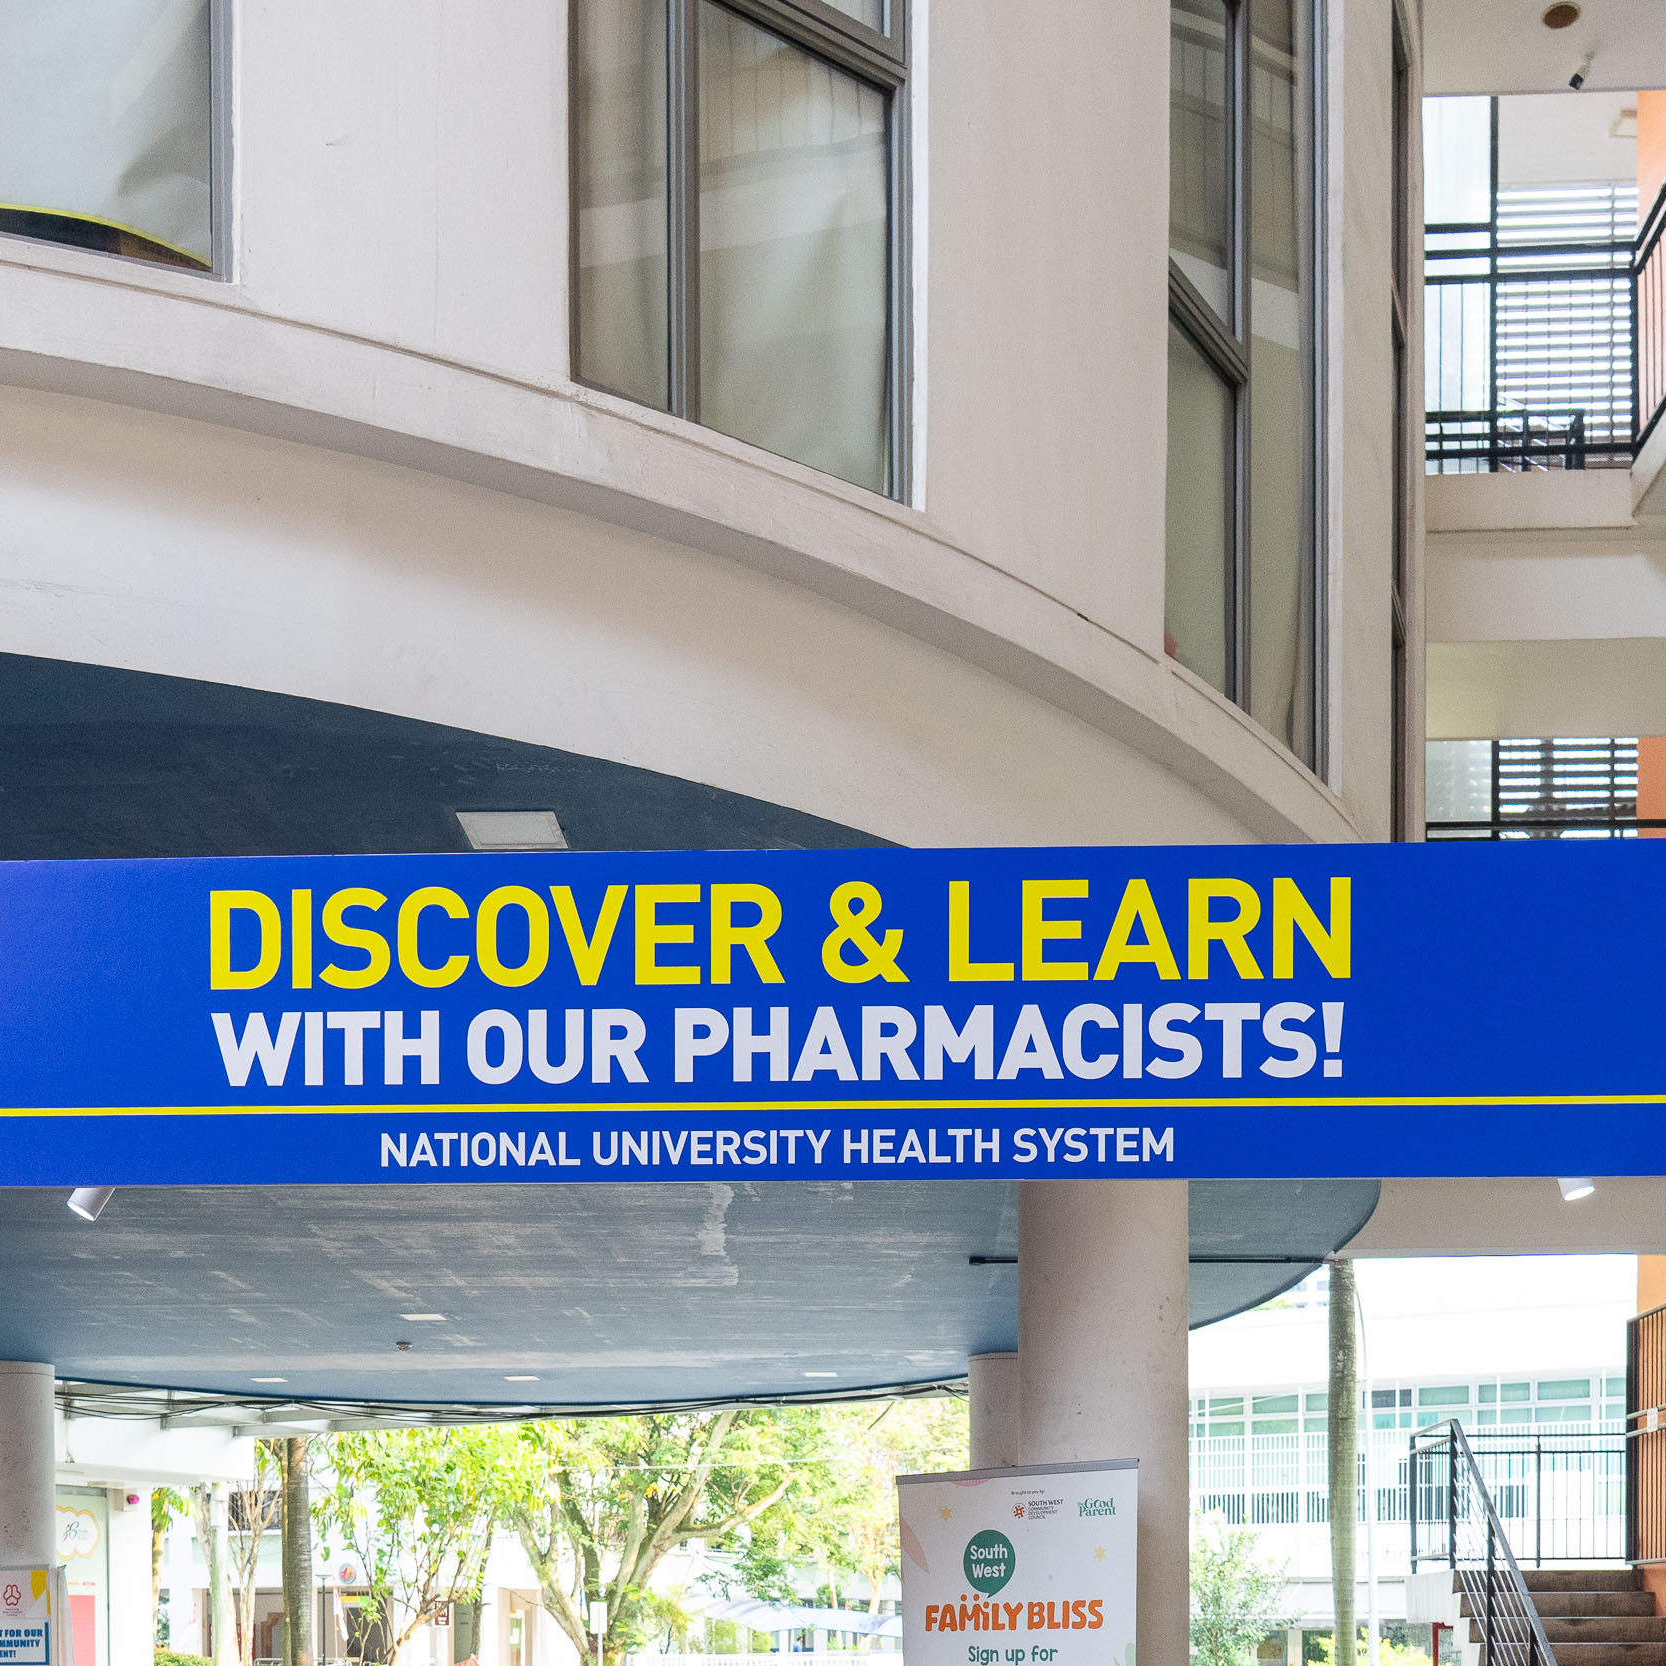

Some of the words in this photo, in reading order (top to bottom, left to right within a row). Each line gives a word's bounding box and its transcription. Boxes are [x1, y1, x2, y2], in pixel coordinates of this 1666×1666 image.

[210, 882, 785, 990] DISCOVER
[821, 880, 910, 984] &
[949, 876, 1352, 982] LEARN
[210, 1009, 440, 1087] WITH
[466, 1008, 650, 1085] OUR
[674, 1001, 1344, 1083] PHARMACISTS!
[380, 1132, 581, 1168] NATIONAL
[593, 1130, 831, 1167] UNIVERSITY
[842, 1128, 1000, 1164] HEALTH
[1012, 1127, 1175, 1163] SYSTEM
[1078, 1505, 1116, 1517] Parent
[1084, 1498, 1114, 1508] Good
[970, 1544, 1008, 1560] South
[972, 1563, 1006, 1578] West
[1027, 1600, 1103, 1630] BLISS
[5, 1629, 22, 1637] FOR
[24, 1629, 43, 1637] OUR
[968, 1646, 999, 1665] Sign
[1005, 1648, 1025, 1665] up
[1031, 1645, 1058, 1661] for
